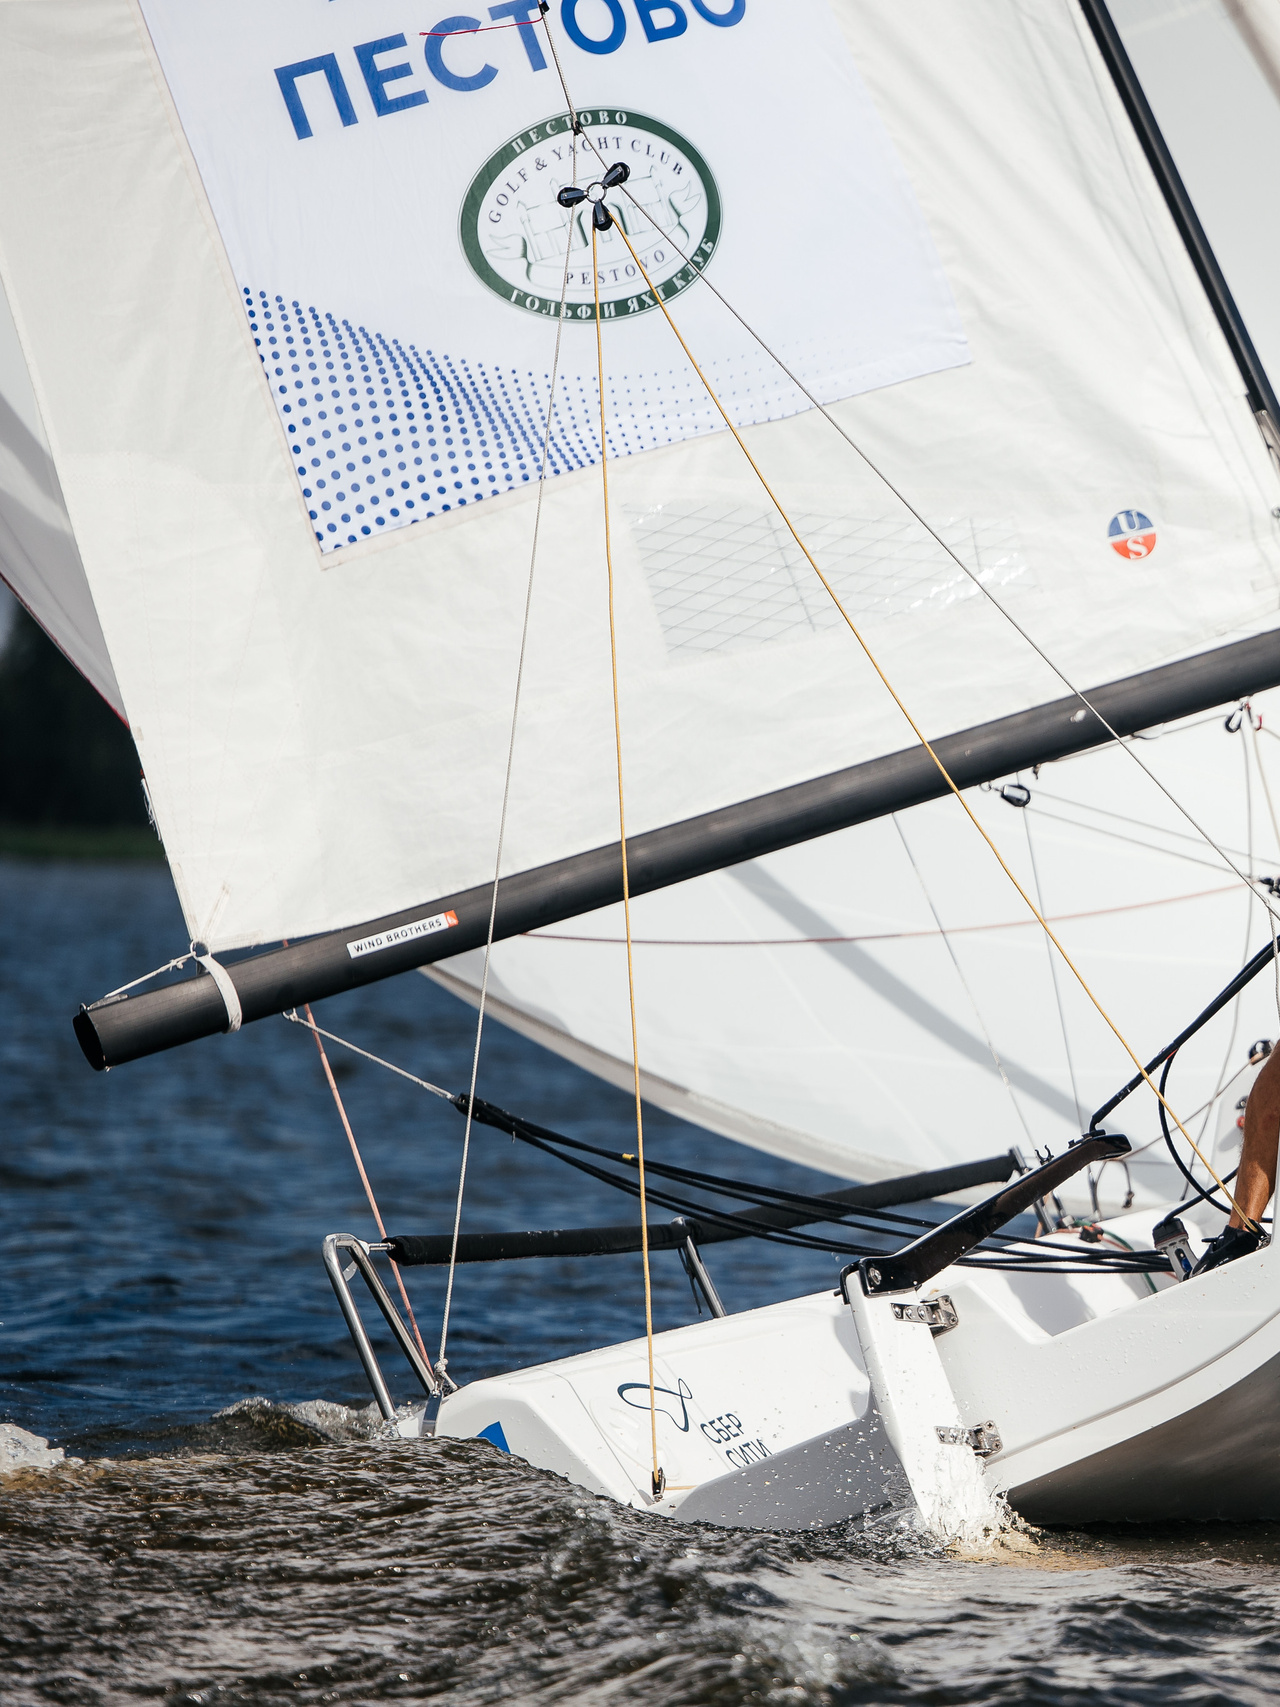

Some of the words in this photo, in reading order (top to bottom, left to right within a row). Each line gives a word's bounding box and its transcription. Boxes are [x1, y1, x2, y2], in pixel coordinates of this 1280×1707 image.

[511, 109, 629, 154] ПЕСТОВО
[488, 169, 530, 224] GOLF
[534, 157, 549, 172] &
[552, 136, 623, 162] YACHT
[631, 139, 684, 176] CLUB
[509, 288, 592, 320] ГОЛЬФ
[603, 300, 617, 318] И
[627, 284, 667, 314] ЯХТ
[673, 239, 716, 296] КЛУБ
[566, 248, 666, 285] PESTOVO
[353, 937, 383, 953] WIND
[386, 918, 442, 943] BROTHERS
[700, 1412, 745, 1444] СБЕР
[725, 1438, 772, 1469] СИТИ
